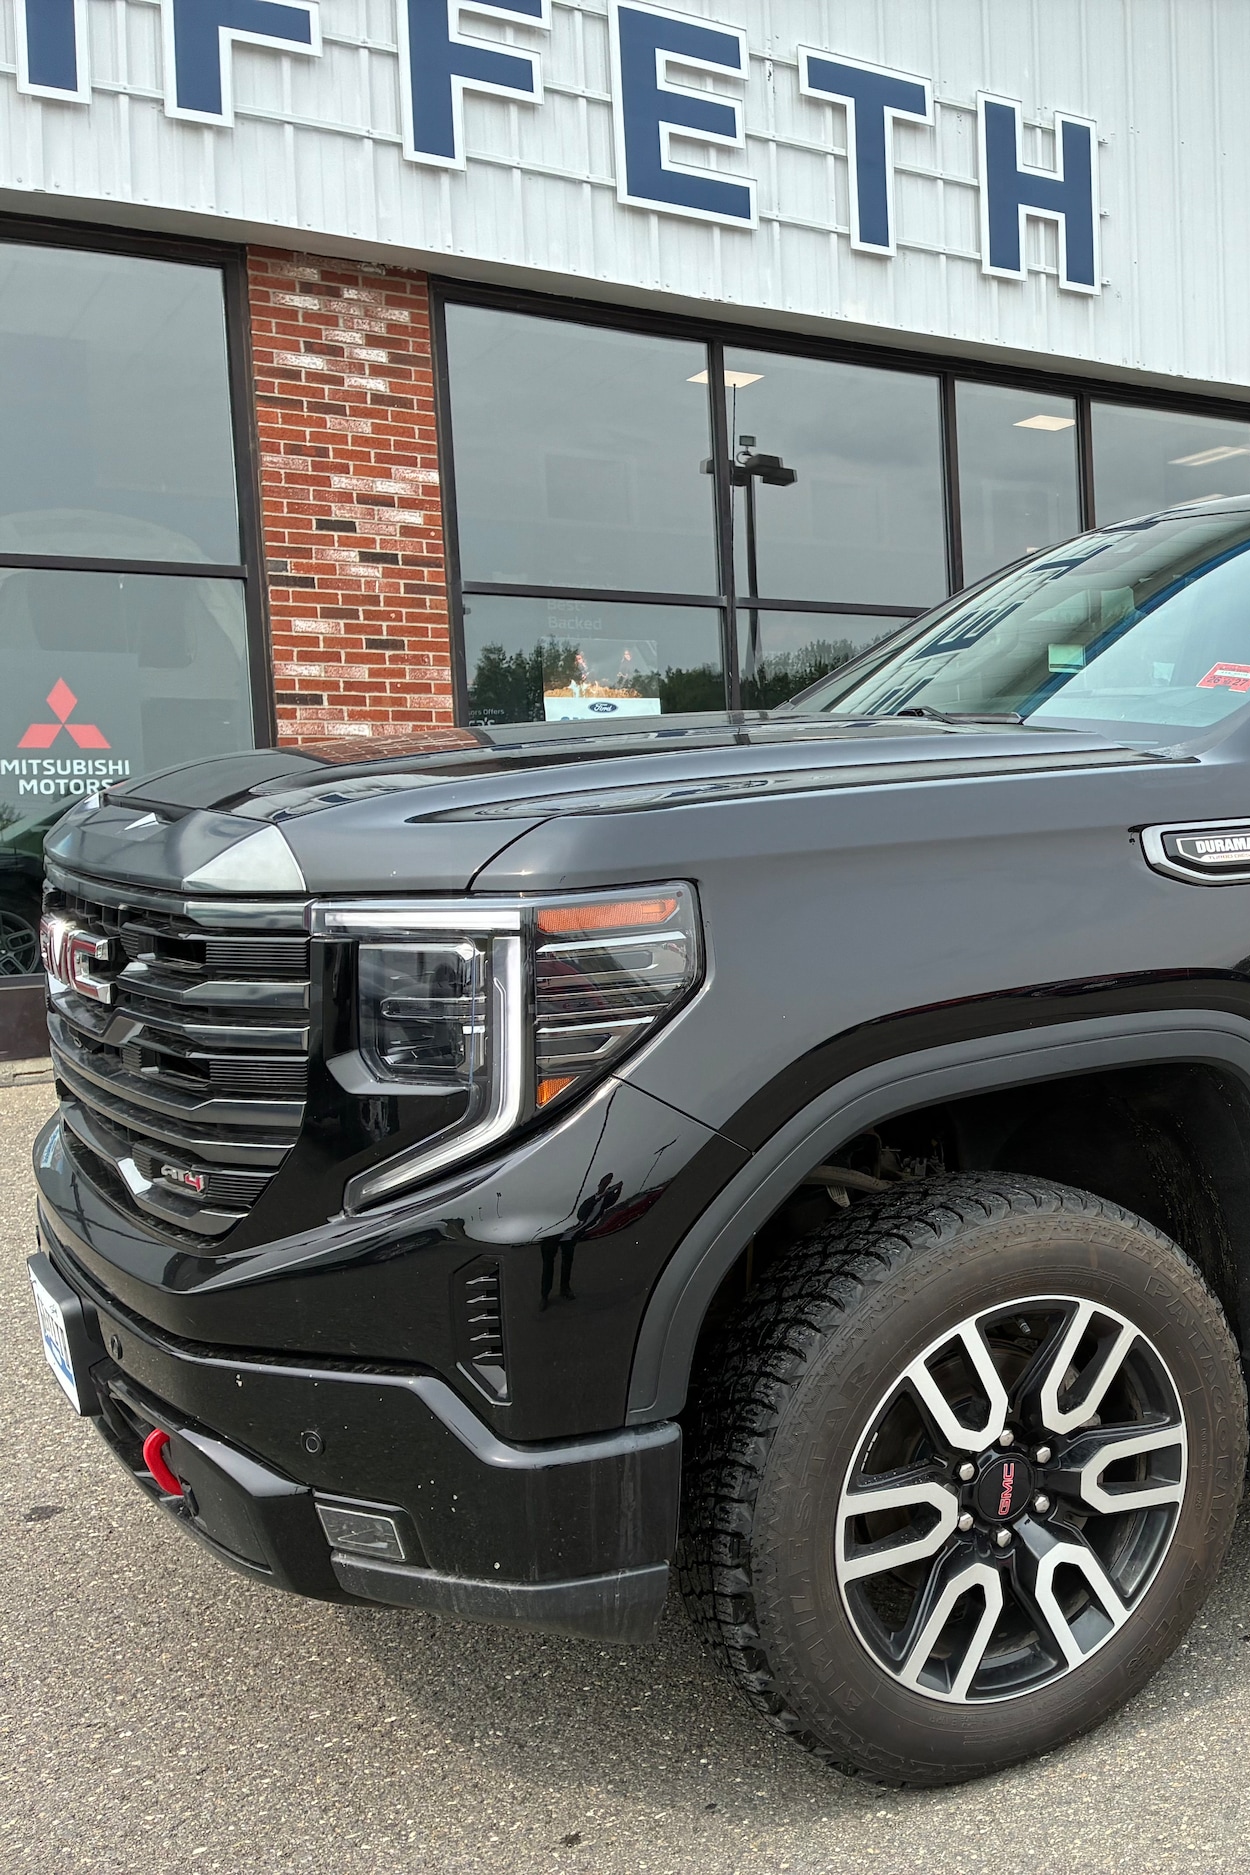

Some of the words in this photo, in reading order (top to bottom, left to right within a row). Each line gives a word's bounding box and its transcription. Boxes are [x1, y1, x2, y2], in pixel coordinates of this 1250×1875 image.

[548, 616, 602, 630] Backed
[593, 704, 613, 712] Ford
[0, 759, 130, 775] MITSUBISHI
[18, 779, 113, 795] MOTORS
[1142, 1273, 1231, 1546] PATAGONIA
[998, 1462, 1015, 1516] GMC
